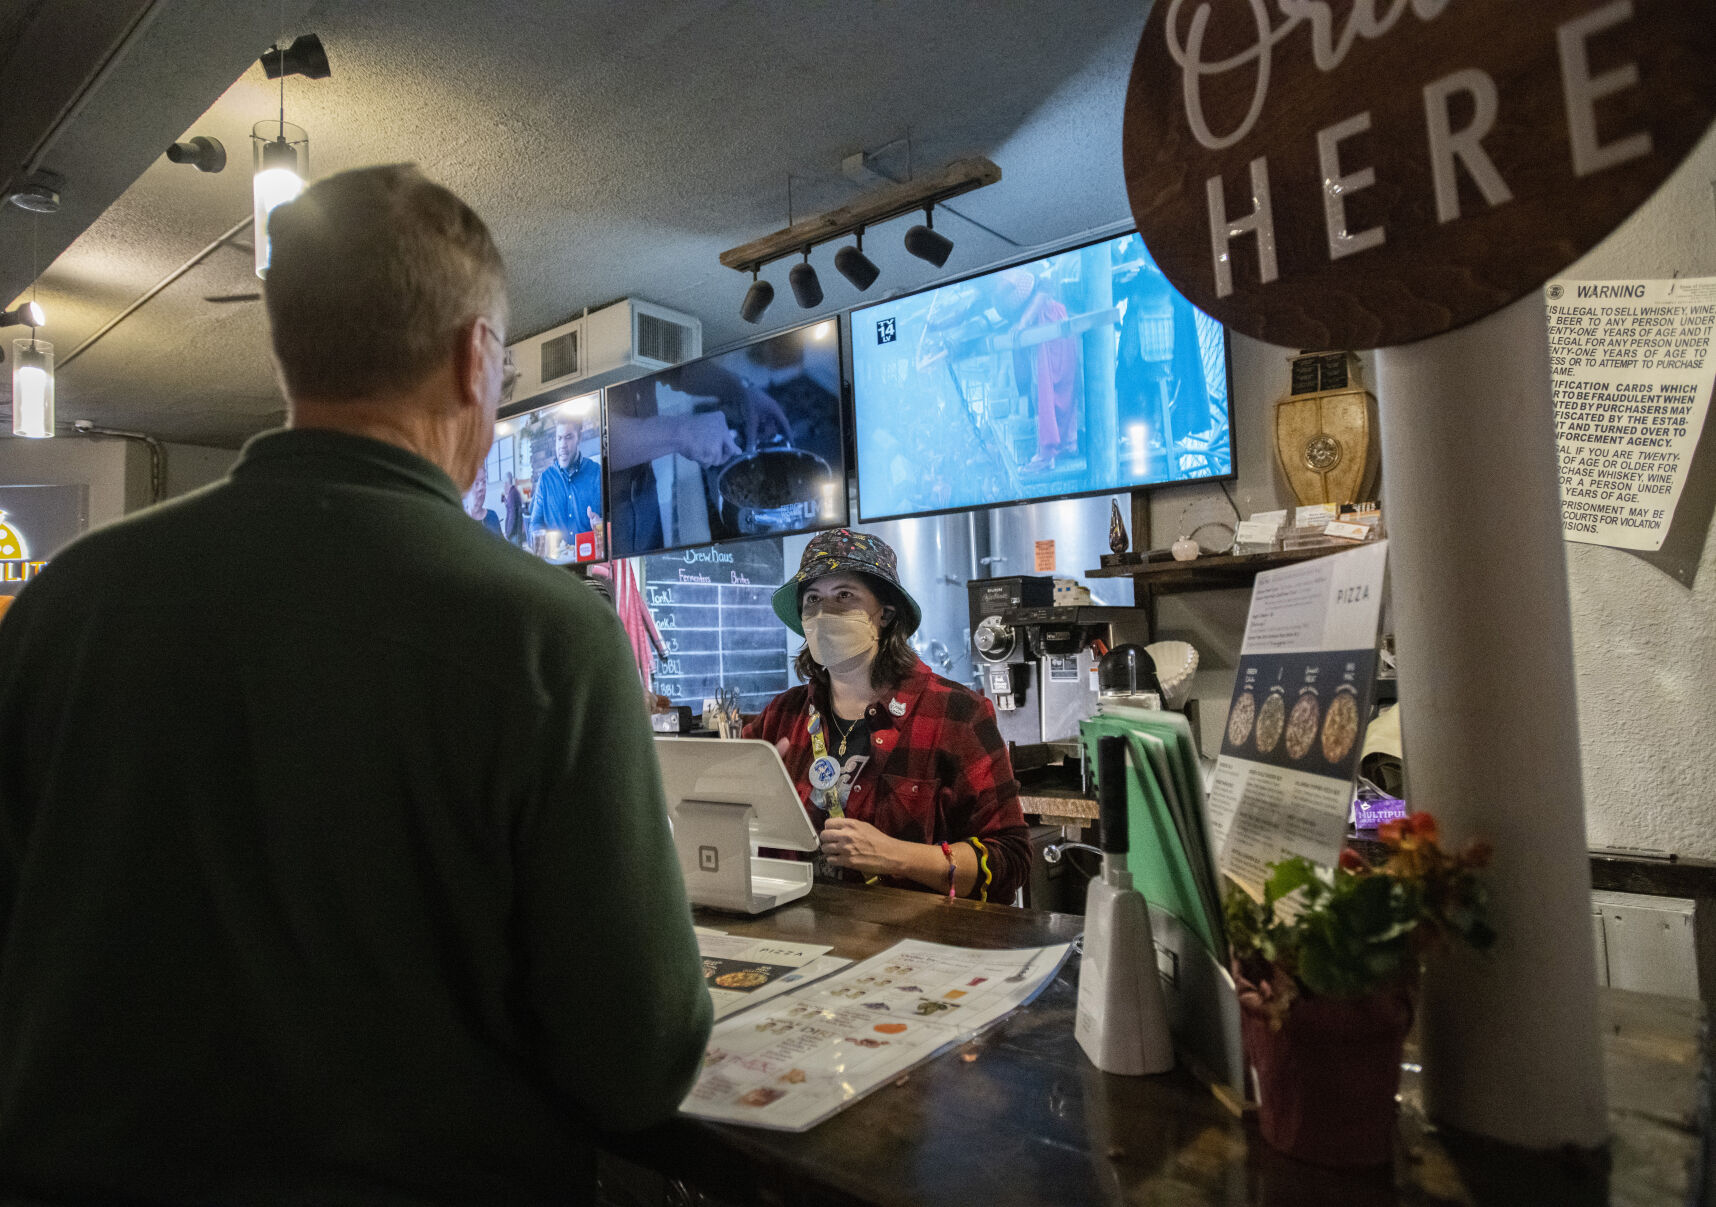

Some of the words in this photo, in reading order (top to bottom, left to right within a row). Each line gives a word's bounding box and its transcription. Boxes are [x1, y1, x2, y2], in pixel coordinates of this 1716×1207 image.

[1206, 0, 1653, 299] HERE
[1577, 285, 1646, 298] WARNING
[1549, 305, 1558, 315] IS
[1559, 306, 1599, 316] ILLEGAL
[1600, 307, 1614, 316] TO
[1614, 307, 1639, 317] SELL
[878, 319, 894, 327] TV
[1556, 316, 1583, 326] BEER
[1589, 317, 1601, 326] TO
[1605, 317, 1627, 327] ANY
[1631, 317, 1675, 327] PERSON
[1680, 315, 1716, 326] UNDER
[878, 324, 895, 337] 14
[1547, 326, 1599, 337] ENTY-ONE
[1603, 327, 1637, 337] YEARS
[1639, 327, 1653, 337] OF
[1655, 327, 1678, 337] AGE
[1679, 326, 1702, 337] AND
[1703, 326, 1714, 336] IT
[1549, 336, 1583, 347] LEGAL
[1585, 338, 1606, 347] FOR
[1607, 338, 1629, 348] ANY
[1630, 338, 1673, 348] PERSON
[1674, 337, 1710, 347] UNDER
[1603, 348, 1638, 358] YEARS
[1643, 349, 1659, 359] OF
[1664, 349, 1688, 359] AGE
[1693, 348, 1708, 358] TO
[1569, 357, 1582, 367] OR
[1585, 358, 1597, 367] TO
[1599, 359, 1639, 369] ATTEMPT
[1642, 360, 1654, 369] TO
[1656, 360, 1705, 369] PURCHASE
[1552, 380, 1610, 391] IFICATION
[1616, 383, 1654, 393] CARDS
[1660, 384, 1698, 394] WHICH
[1562, 391, 1576, 400] TO
[1576, 391, 1591, 401] BE
[1592, 392, 1663, 404] FRAUDULENT
[1663, 395, 1696, 405] WHEN
[1580, 402, 1595, 411] BY
[1596, 403, 1669, 415] PURCHASERS
[1670, 406, 1693, 415] MAY
[1555, 410, 1605, 423] FISCATED
[1608, 414, 1624, 424] BY
[1627, 415, 1649, 425] THE
[1652, 416, 1689, 426] ESTAB-
[1568, 422, 1591, 432] AND
[1594, 424, 1638, 435] TURNED
[1640, 426, 1670, 437] OVER
[1673, 427, 1687, 437] TO
[1626, 436, 1673, 448] AGENCY.
[1575, 446, 1585, 455] IF
[1589, 447, 1610, 458] YOU
[1612, 449, 1634, 460] ARE
[1638, 451, 1680, 462] TWENTY-
[1563, 455, 1577, 465] OF
[1578, 457, 1601, 468] AGE
[1603, 459, 1618, 469] OR
[1620, 460, 1655, 472] OLDER
[1657, 463, 1678, 473] FOR
[1558, 465, 1595, 478] CHASE
[1577, 478, 1584, 487] A
[1590, 479, 1633, 492] PERSON
[1638, 483, 1673, 495] UNDER
[1566, 487, 1599, 499] YEARS
[1600, 490, 1615, 500] OF
[1561, 500, 1625, 516] PRISONMENT
[1629, 507, 1650, 518] MAY
[1652, 509, 1665, 519] BE
[1562, 510, 1599, 523] COURTS
[1599, 515, 1619, 526] FOR
[1620, 517, 1662, 530] VIOLATION
[1562, 520, 1599, 534] ISIONS.
[1337, 585, 1370, 605] PIZZA
[760, 948, 803, 957] PIZZA
